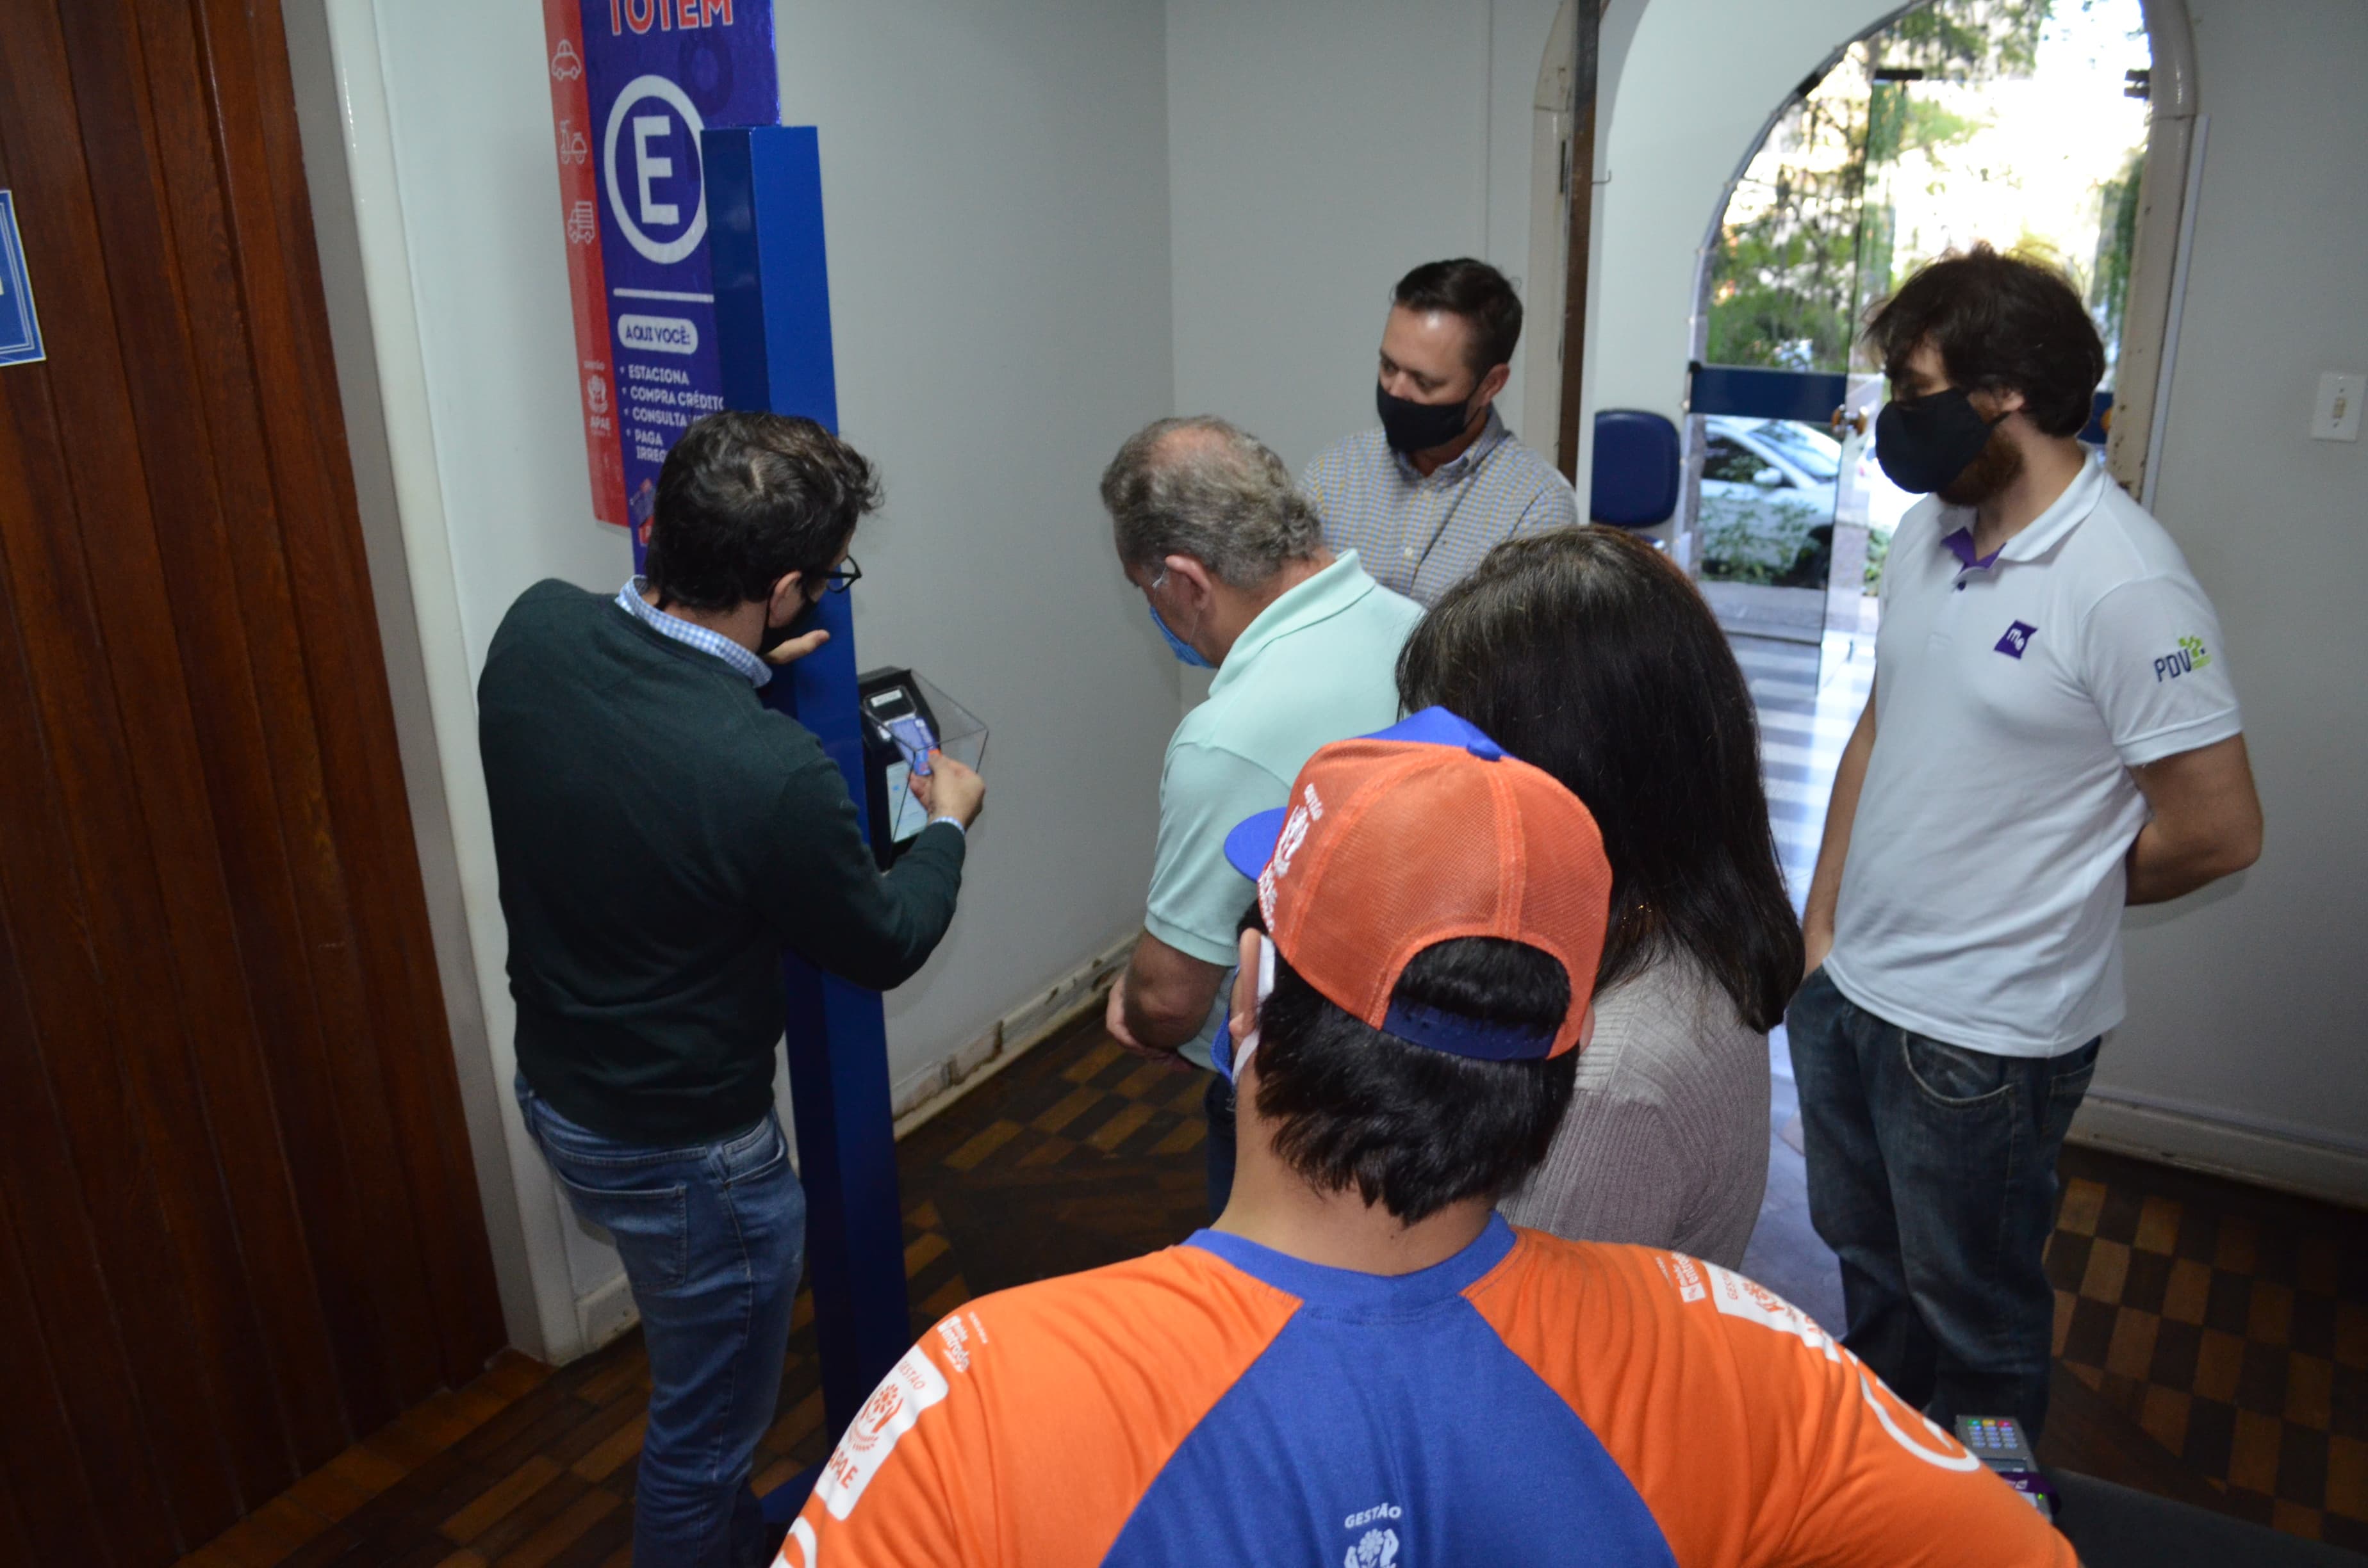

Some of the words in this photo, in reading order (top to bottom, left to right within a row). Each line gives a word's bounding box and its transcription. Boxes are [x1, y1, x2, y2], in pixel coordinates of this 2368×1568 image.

[633, 115, 679, 225] E
[625, 325, 653, 342] AQUI
[654, 325, 691, 345] VOCÊ:
[628, 364, 689, 386] ESTACIONA
[630, 386, 677, 405] COMPRA
[632, 406, 687, 427] CONSULTA
[634, 428, 663, 446] PAGA
[2153, 648, 2192, 683] PDV
[1344, 1503, 1402, 1529] GESTÃO
